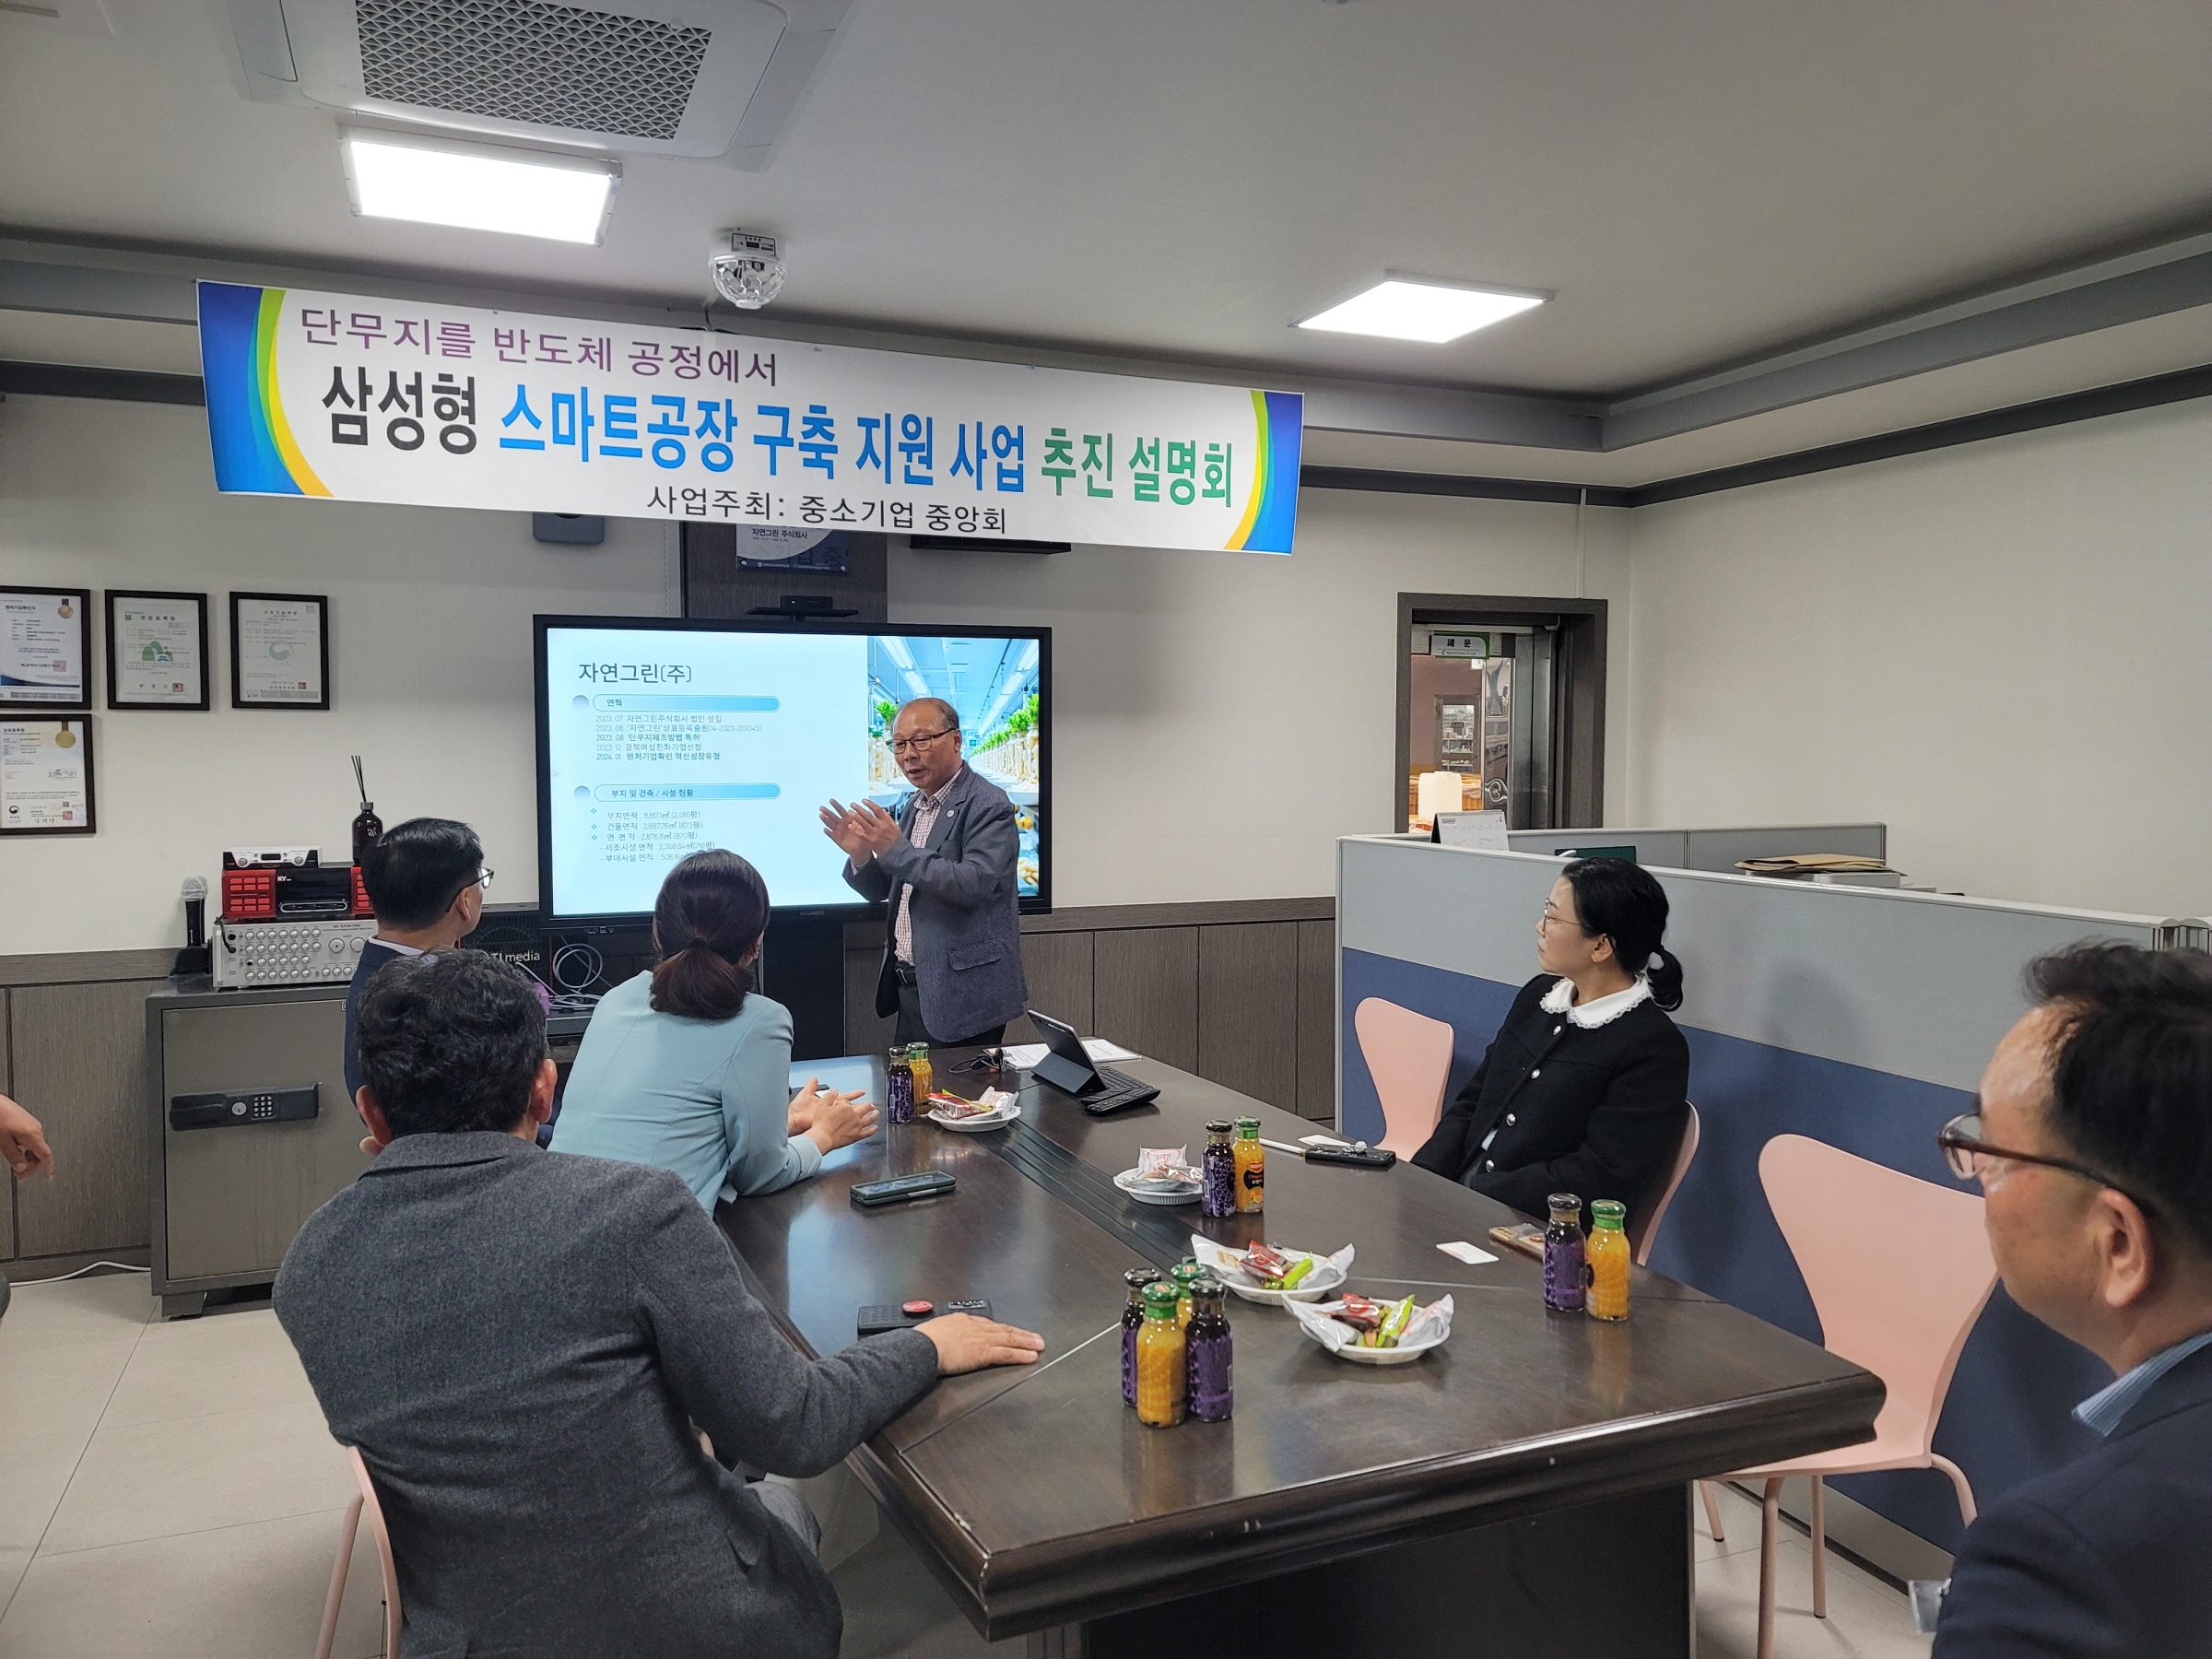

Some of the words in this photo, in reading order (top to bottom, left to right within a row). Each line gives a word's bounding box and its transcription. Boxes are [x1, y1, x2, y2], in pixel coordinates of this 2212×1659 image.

[300, 308, 477, 359] 단무지를
[492, 326, 613, 371] 반도체
[628, 339, 777, 387] 공정에서
[322, 365, 478, 455] 삼성형
[499, 383, 738, 473] 스마트공장
[753, 403, 839, 480] 구축
[855, 412, 935, 486] 지원
[949, 420, 1026, 494] 사업
[1041, 428, 1114, 499] 추진
[1128, 435, 1233, 508] 설명회
[647, 485, 785, 521] 사업주최:
[798, 494, 914, 530] 중소기업
[924, 504, 1006, 535] 중앙회
[752, 528, 779, 537] 자연그린
[781, 530, 807, 539] 주식회사
[579, 663, 692, 684] 자연그린(주)
[606, 699, 622, 707] 연혁
[627, 714, 688, 724] 자연그린주식회사
[690, 714, 705, 724] 법인
[707, 714, 723, 724] 설립
[627, 752, 673, 761] 벤처기업확인
[675, 752, 720, 761] 혁신성장유형
[611, 789, 627, 798] 부지
[629, 789, 637, 798] 및
[639, 789, 654, 797] 건축
[661, 789, 677, 797] 시설
[678, 788, 694, 797] 현황
[606, 811, 638, 820] 부지면적
[606, 822, 638, 831] 건물면적
[606, 843, 636, 853] 제조시설
[638, 842, 653, 852] 면적
[606, 853, 637, 863] 부대시설
[638, 853, 653, 862] 면적
[505, 950, 541, 962] media
